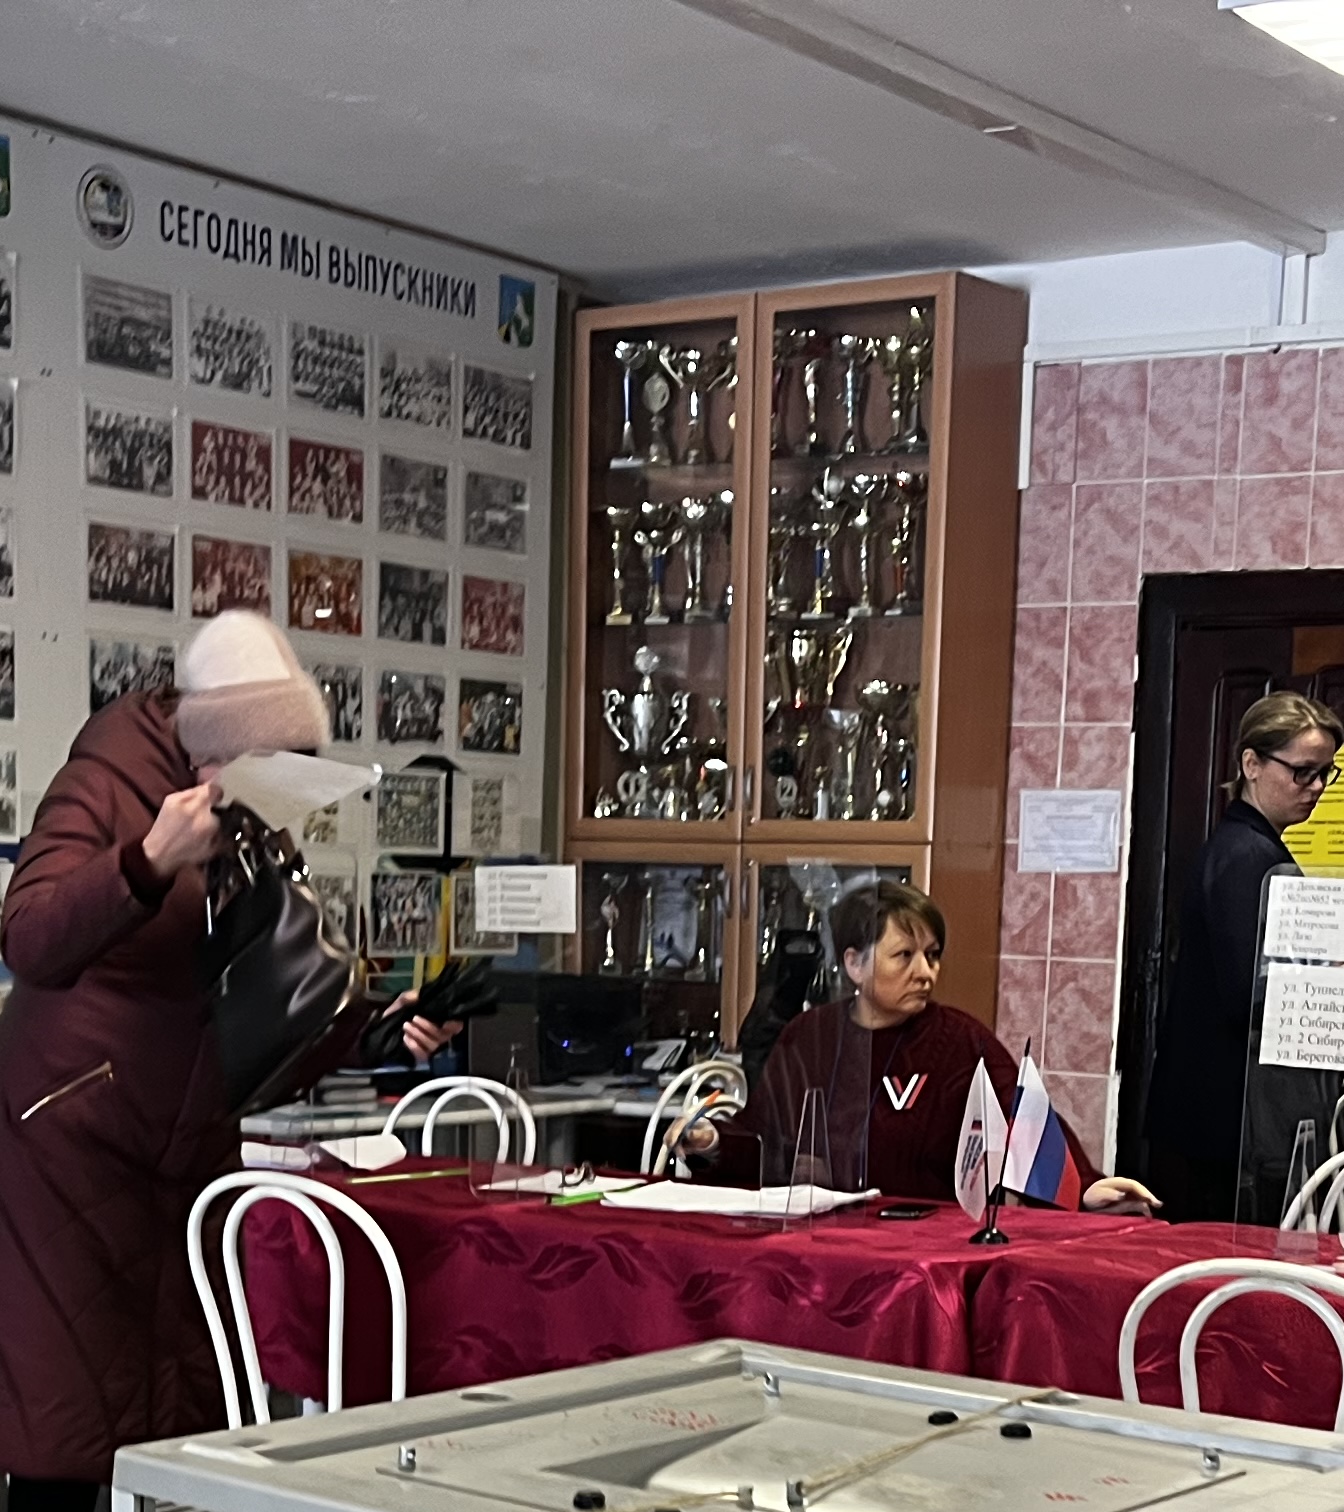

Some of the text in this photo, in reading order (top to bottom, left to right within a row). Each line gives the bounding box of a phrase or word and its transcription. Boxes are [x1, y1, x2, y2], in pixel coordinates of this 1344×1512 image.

[160, 200, 478, 319] СЕГОДНЯ МЫ ВЫПУСКНИКИ
[1297, 1032, 1305, 1044] 2
